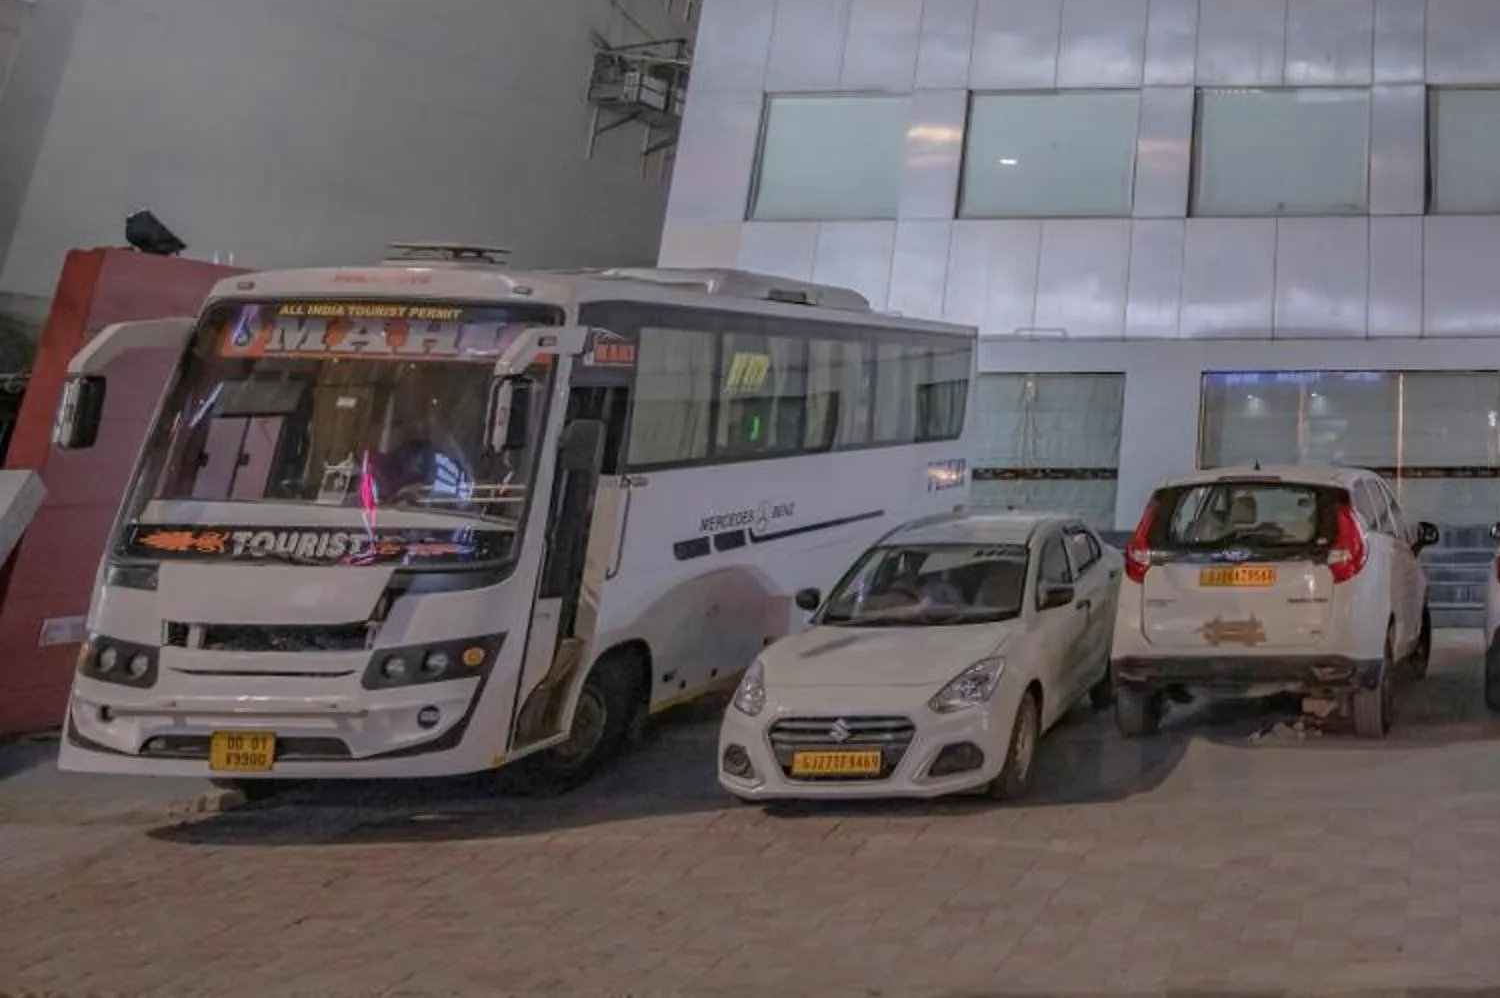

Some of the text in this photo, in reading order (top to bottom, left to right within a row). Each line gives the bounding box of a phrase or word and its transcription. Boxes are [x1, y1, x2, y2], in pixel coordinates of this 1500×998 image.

[278, 303, 463, 320] ALL INDIA TOURIST PERMIT
[700, 501, 796, 532] MERCEDES BENZ
[230, 530, 366, 558] TOURIST
